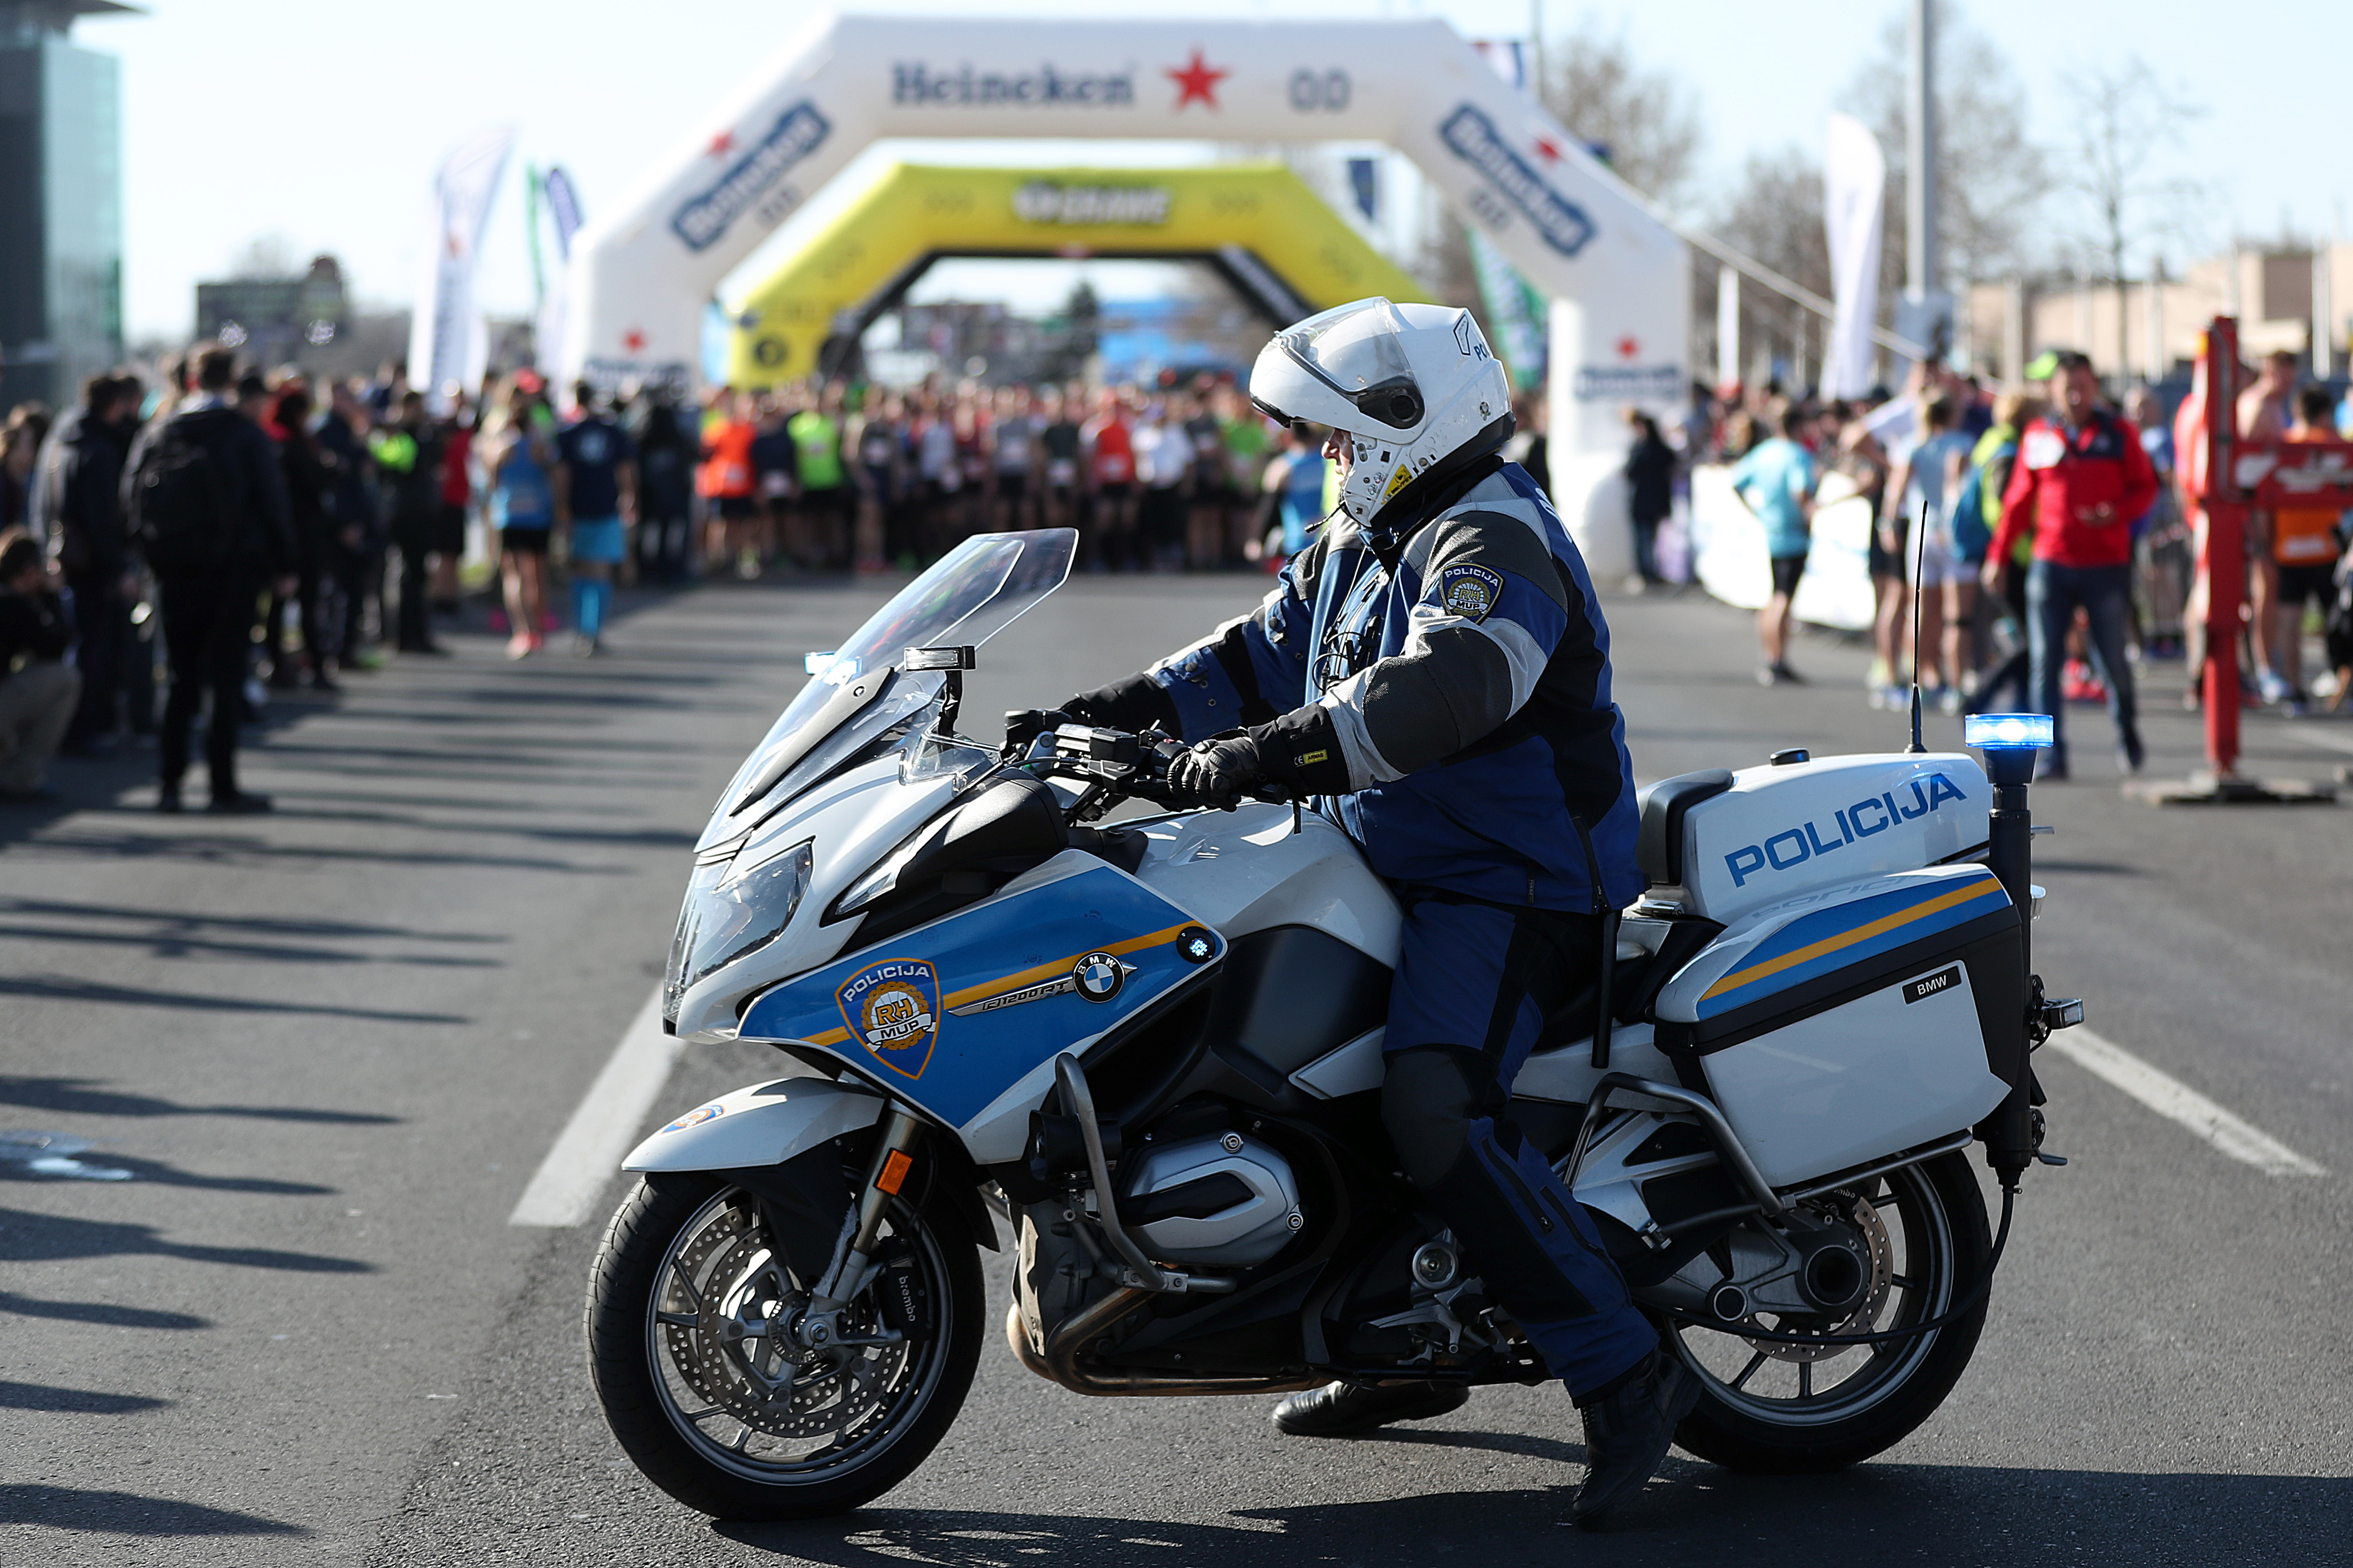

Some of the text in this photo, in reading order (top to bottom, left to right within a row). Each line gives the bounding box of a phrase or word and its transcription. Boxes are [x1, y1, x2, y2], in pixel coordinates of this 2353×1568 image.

[892, 61, 1135, 105] Heineken
[1445, 568, 1498, 587] POLICIJA
[1456, 600, 1480, 609] MUP
[1459, 588, 1481, 601] RH
[1724, 772, 1967, 888] POLICIJA
[1078, 955, 1116, 975] BMW
[843, 965, 930, 1002] POLICIJA
[1917, 975, 1947, 996] BMW
[875, 997, 913, 1026] RH
[881, 1019, 919, 1039] MUP
[898, 1275, 916, 1322] brembo
